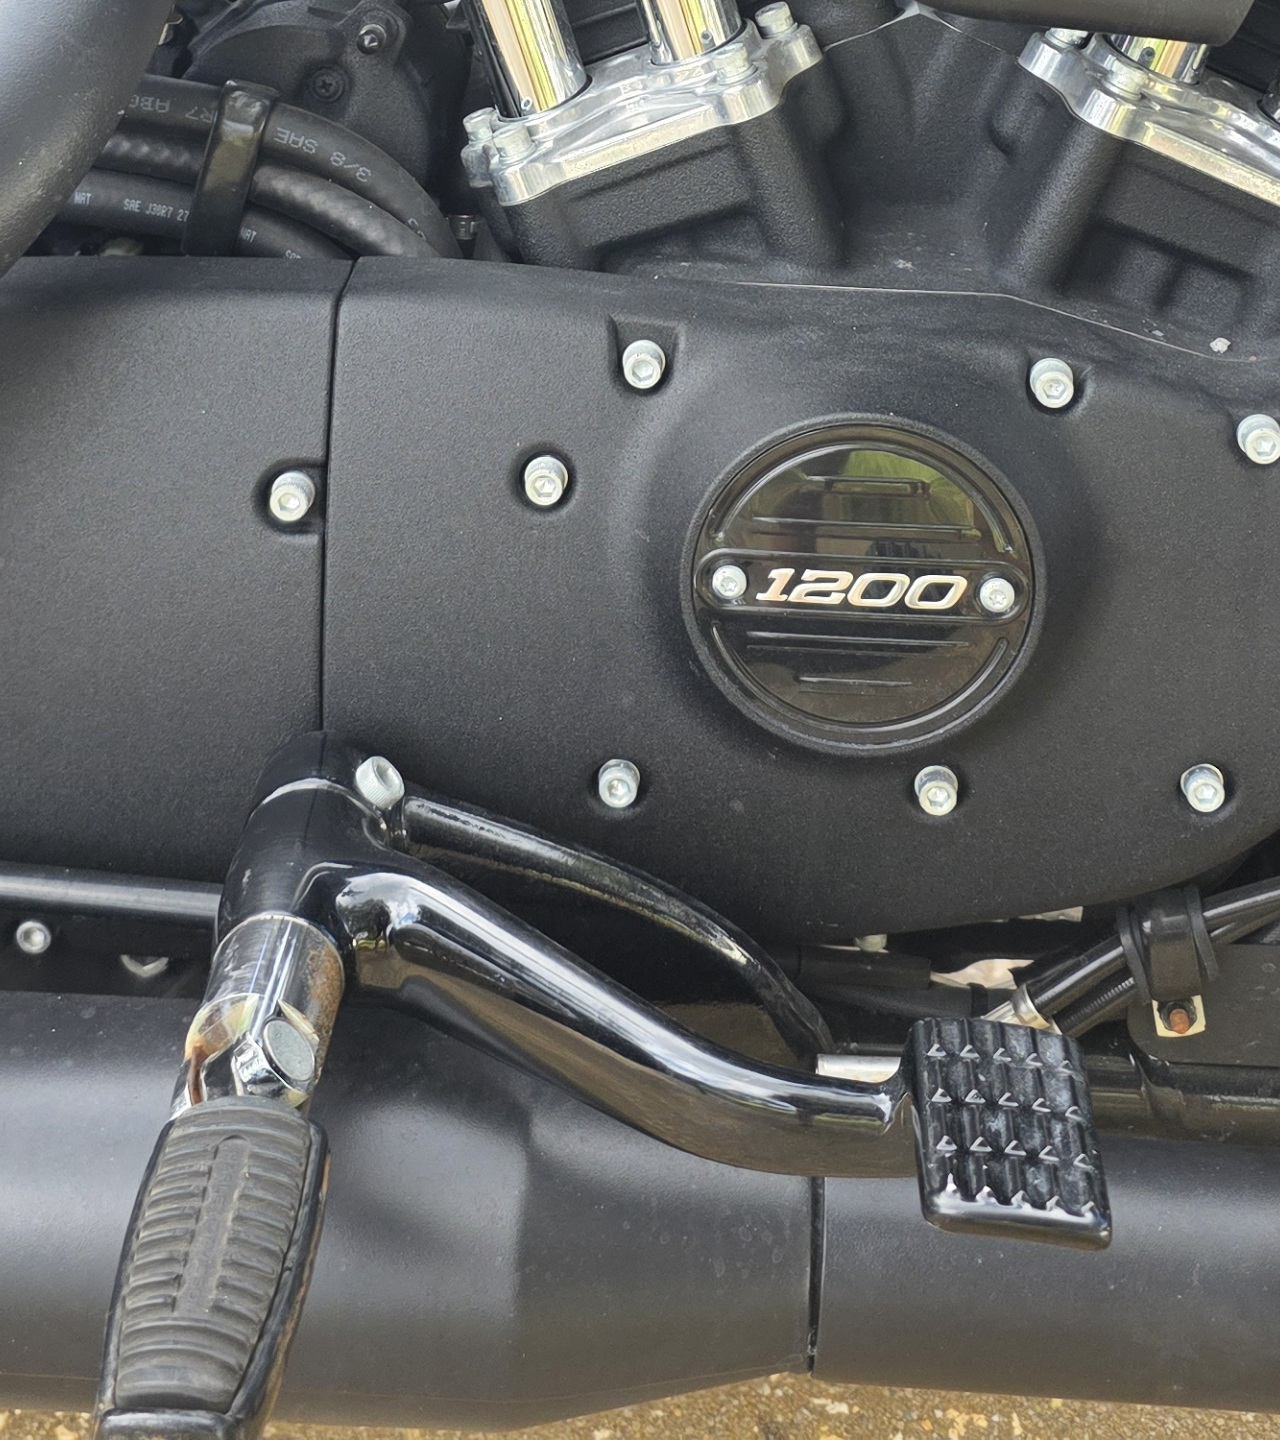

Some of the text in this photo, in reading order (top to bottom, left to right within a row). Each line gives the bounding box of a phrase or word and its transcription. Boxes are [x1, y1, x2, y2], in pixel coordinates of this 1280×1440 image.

[273, 127, 319, 155] SAE
[123, 198, 143, 212] SAE
[756, 568, 967, 610] 1200
